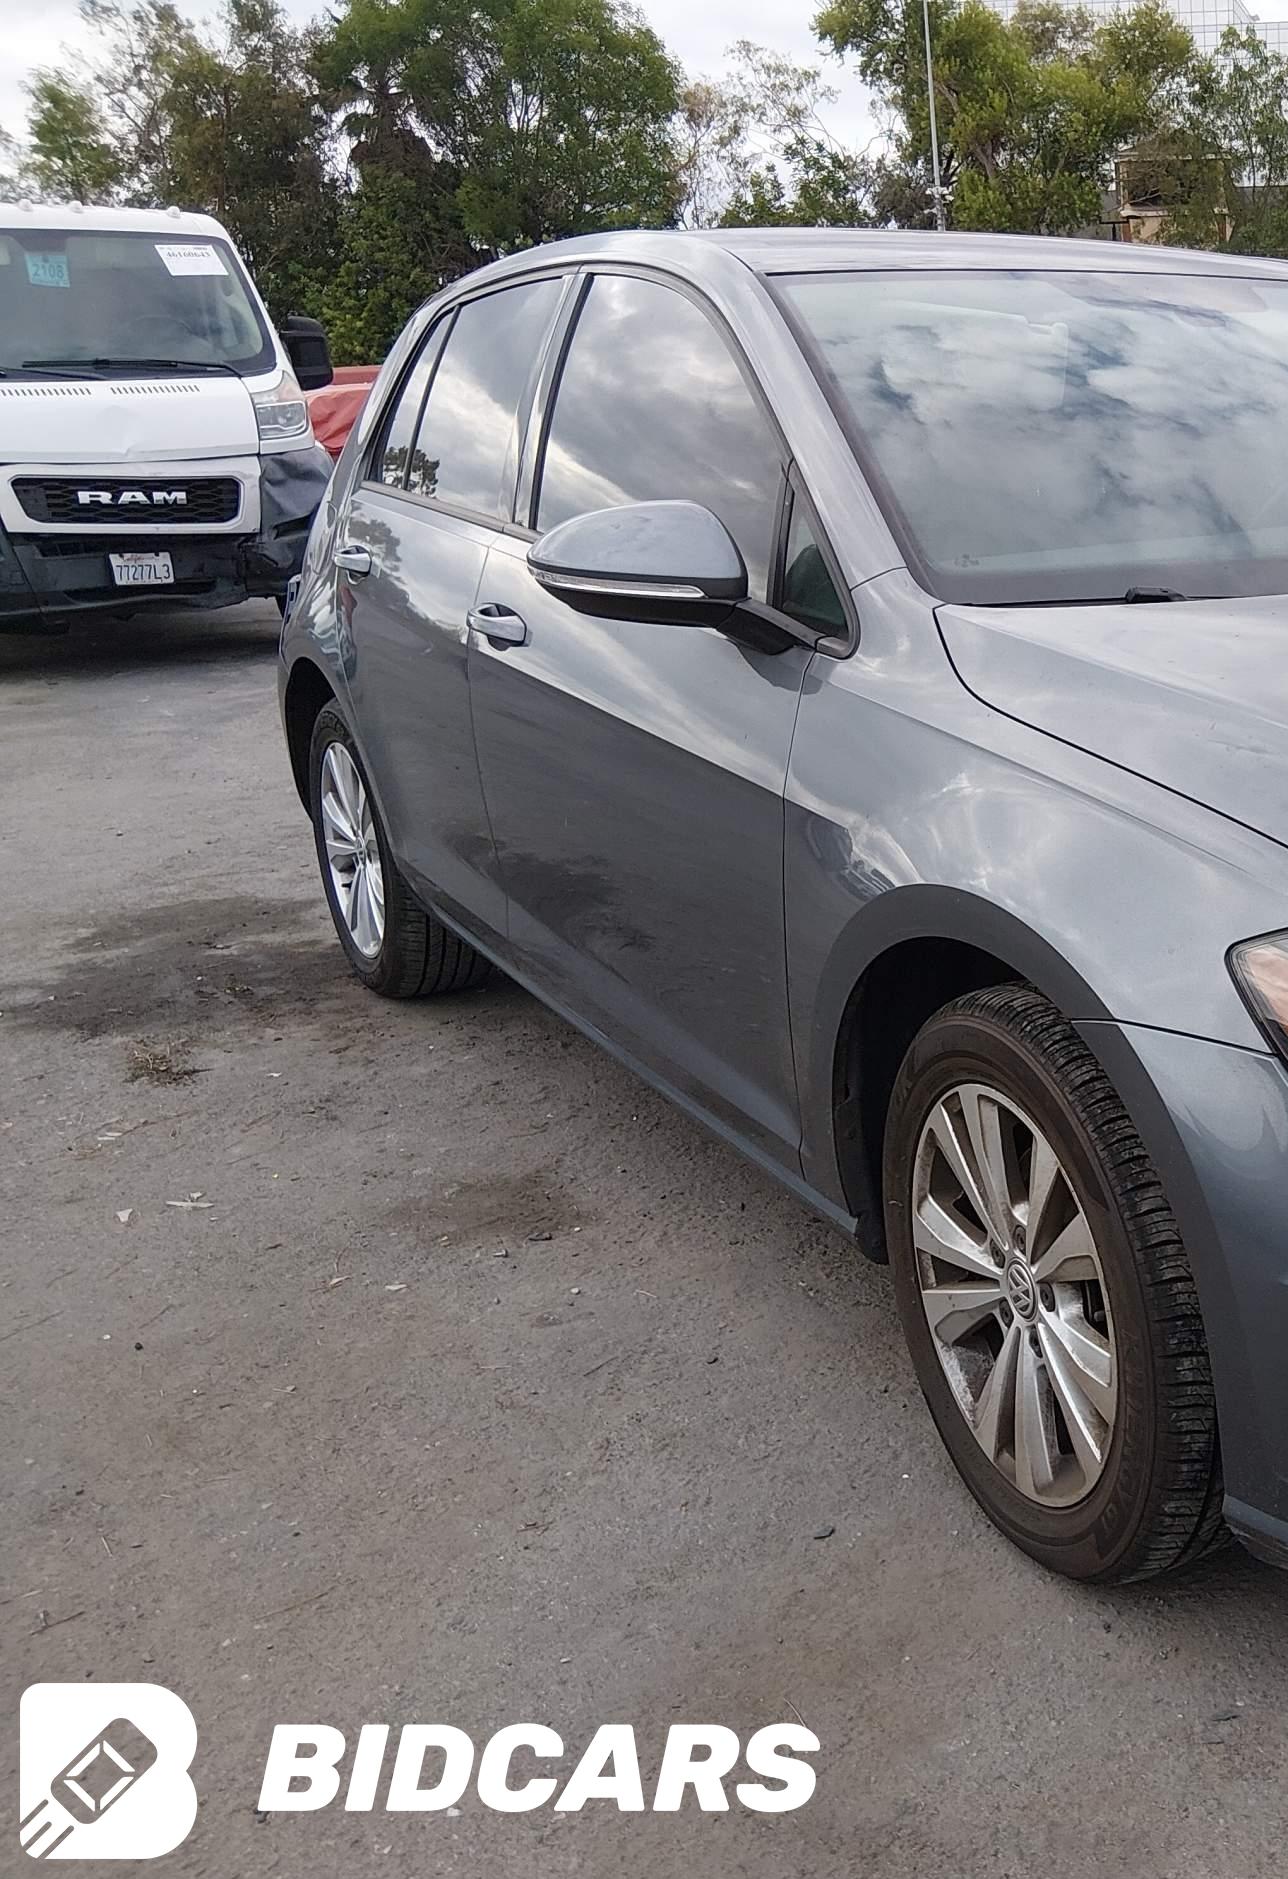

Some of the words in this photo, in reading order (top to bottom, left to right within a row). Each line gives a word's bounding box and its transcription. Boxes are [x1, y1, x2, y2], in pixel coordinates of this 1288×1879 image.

[32, 263, 65, 279] 2108
[78, 491, 187, 505] RAM
[115, 564, 170, 580] 77277L3
